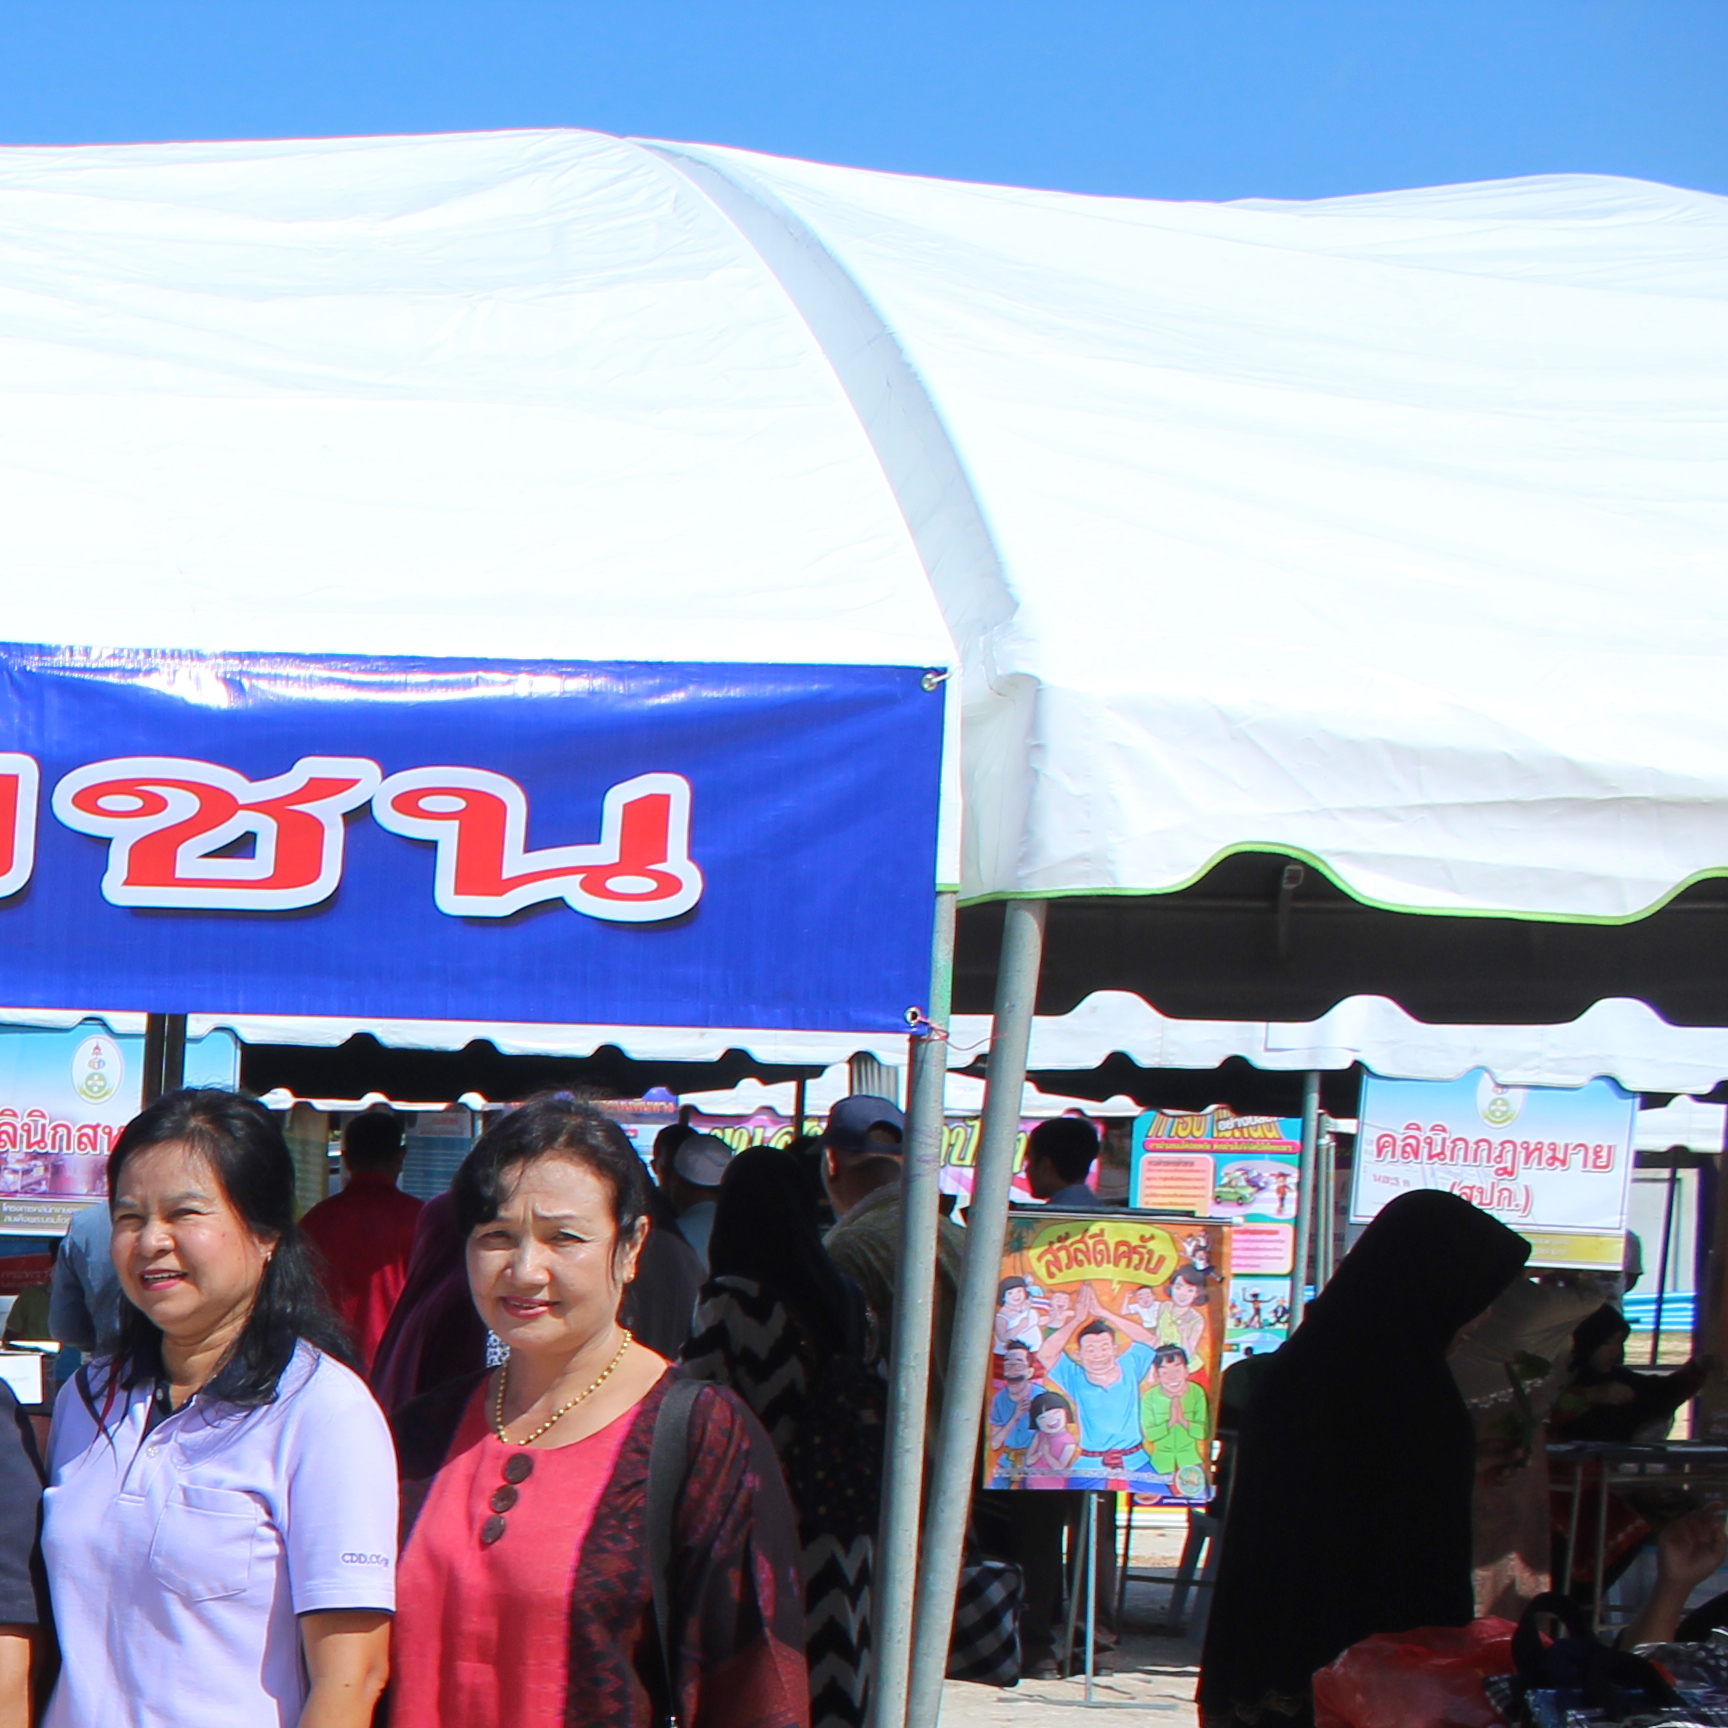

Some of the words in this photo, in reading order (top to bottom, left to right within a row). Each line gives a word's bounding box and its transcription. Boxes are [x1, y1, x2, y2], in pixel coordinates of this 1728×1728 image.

[1374, 1122, 1614, 1179] คลินิกกฎหมาย
[1036, 1226, 1167, 1279] สวัสดีครับ
